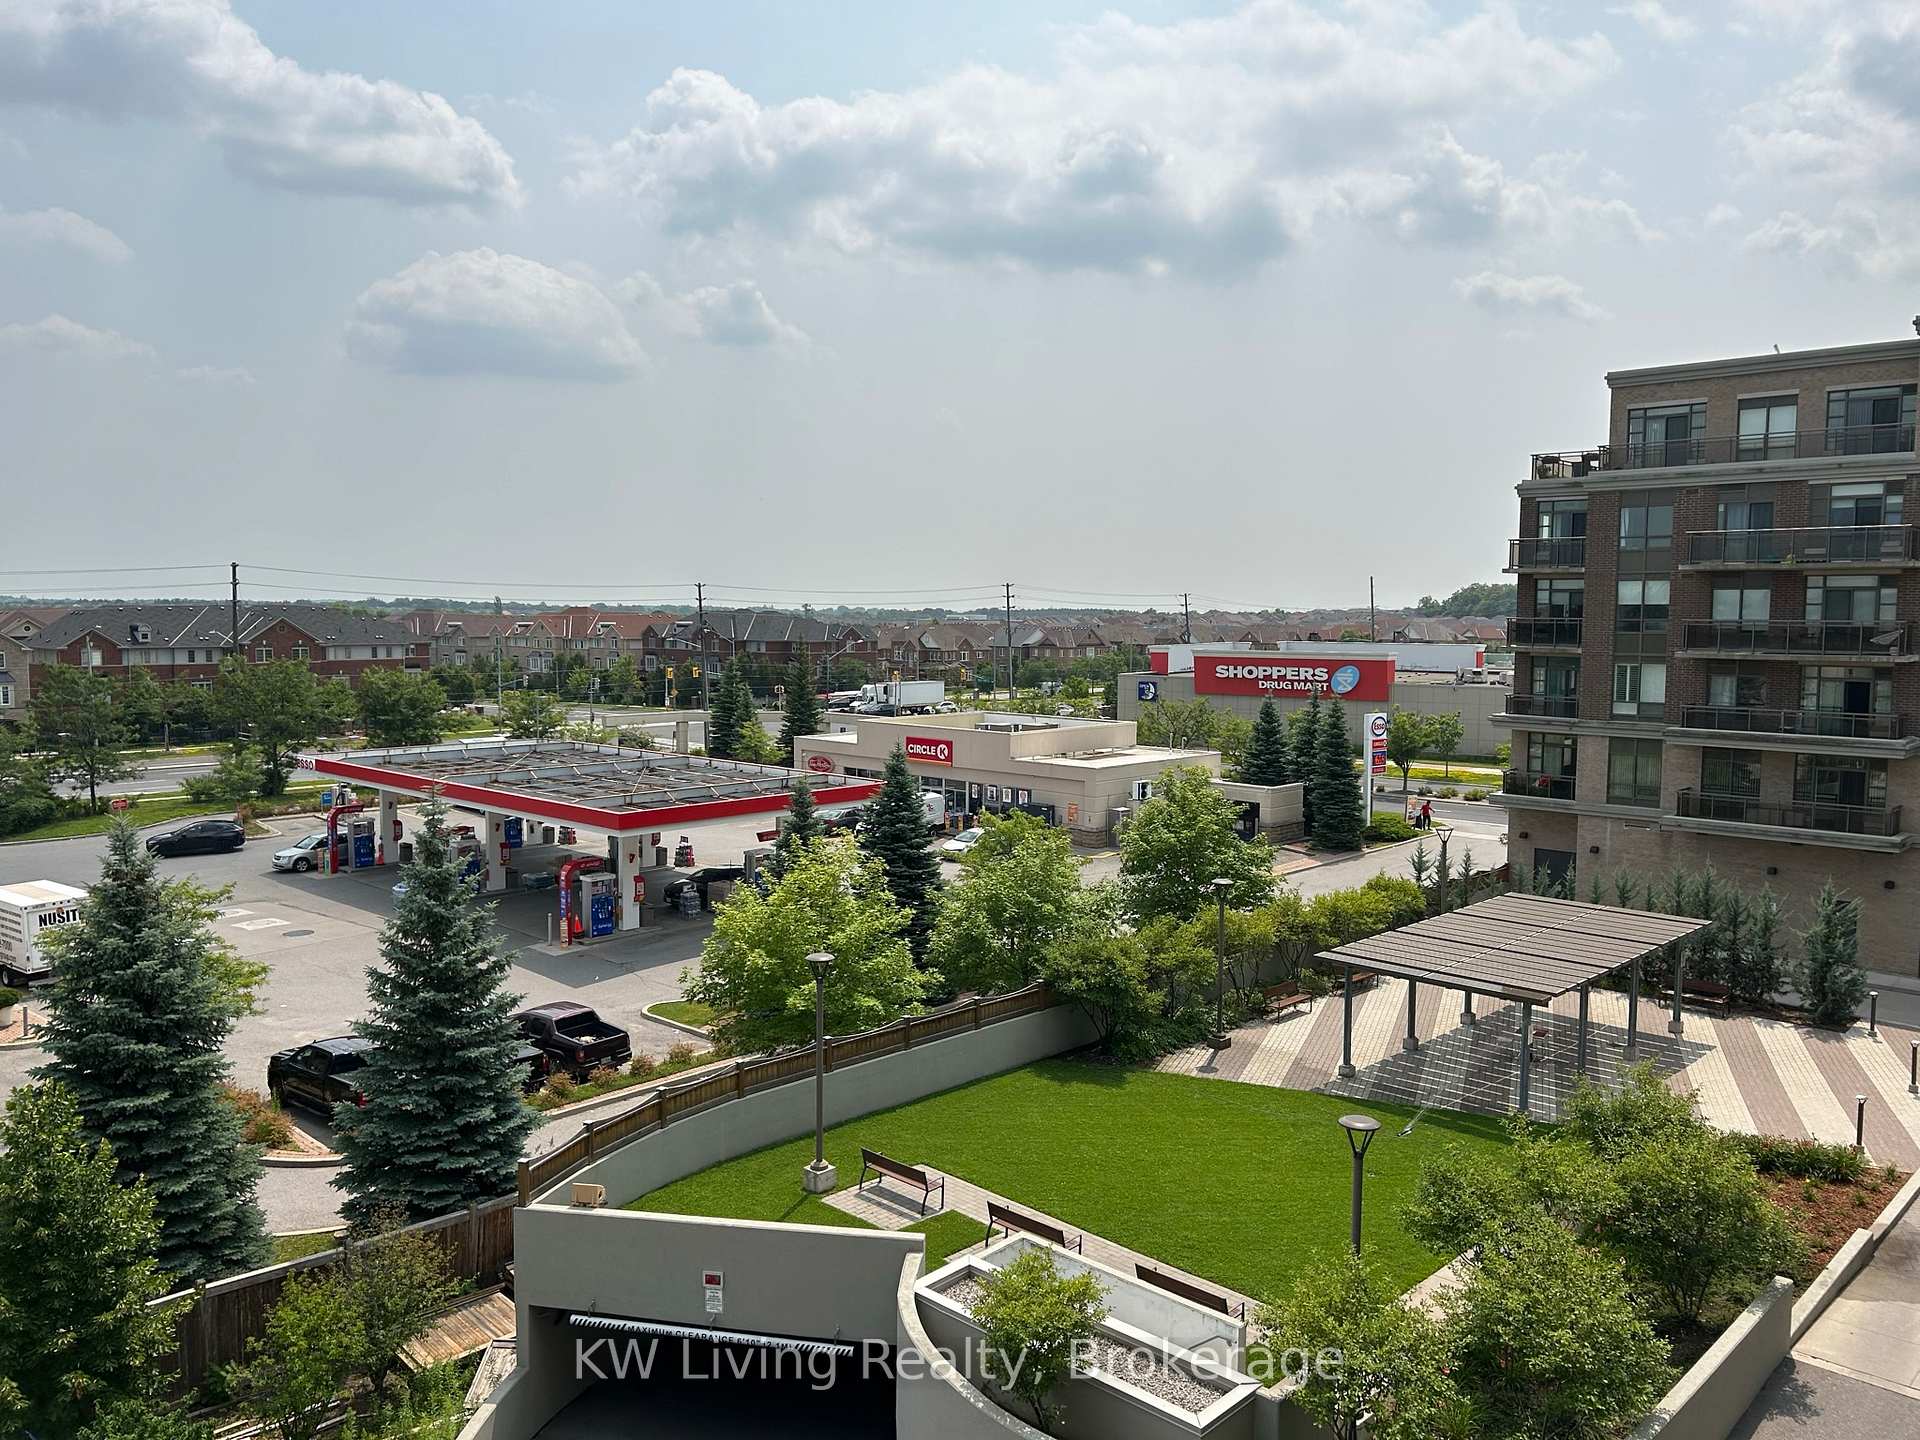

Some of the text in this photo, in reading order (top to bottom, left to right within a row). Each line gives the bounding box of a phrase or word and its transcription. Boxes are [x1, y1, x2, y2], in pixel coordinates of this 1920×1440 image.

[1215, 665, 1328, 681] SHOPPERS
[1258, 680, 1328, 691] DRUG MART
[907, 743, 948, 759] CIRCLE K
[38, 908, 82, 928] NUSIT
[675, 1329, 734, 1344] CLEARANCE
